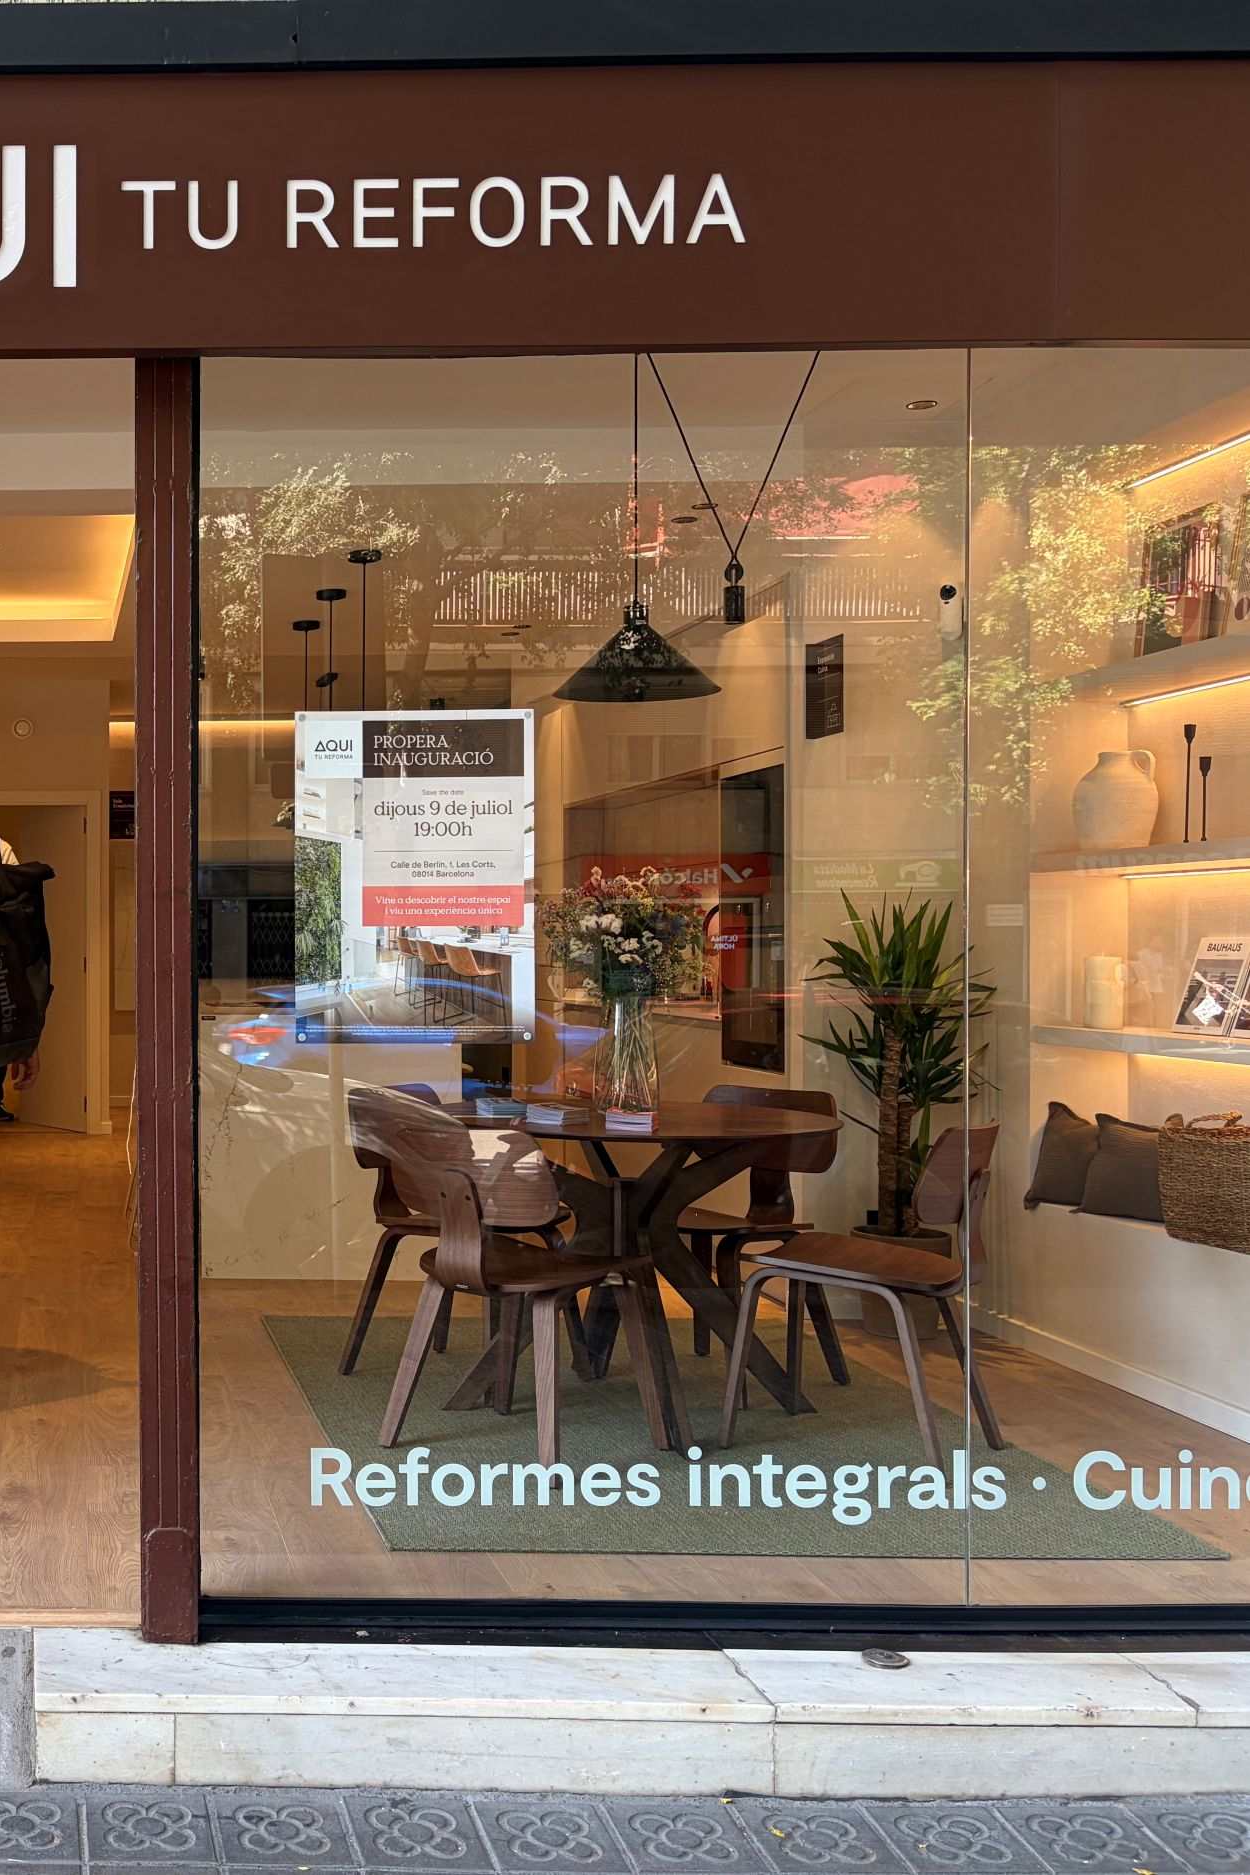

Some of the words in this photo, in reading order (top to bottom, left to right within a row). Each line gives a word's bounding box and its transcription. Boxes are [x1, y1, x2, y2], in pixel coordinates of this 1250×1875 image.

[121, 180, 238, 250] TU
[286, 174, 746, 249] REFORMA
[314, 739, 353, 752] AQUI
[373, 735, 449, 749] PROPERA
[373, 748, 494, 766] INAUGURACIÓ
[374, 800, 426, 821] dijous
[429, 800, 441, 816] 9
[445, 800, 468, 816] de
[469, 799, 514, 819] juliol
[413, 820, 473, 837] 19:00h
[390, 860, 411, 869] Calle
[411, 860, 422, 869] de
[456, 860, 470, 869] Les
[411, 870, 434, 878] 08014
[435, 870, 475, 878] Barcelona
[375, 895, 396, 905] Vine
[405, 895, 447, 904] descobrir
[448, 895, 457, 904] el
[458, 896, 487, 904] nostre
[487, 895, 511, 906] espai
[390, 906, 404, 915] viu
[1206, 943, 1243, 952] BAUHAUS
[310, 1446, 661, 1508] Reformes
[687, 1446, 1007, 1526] integrals
[1073, 1449, 1250, 1511] Cuin
